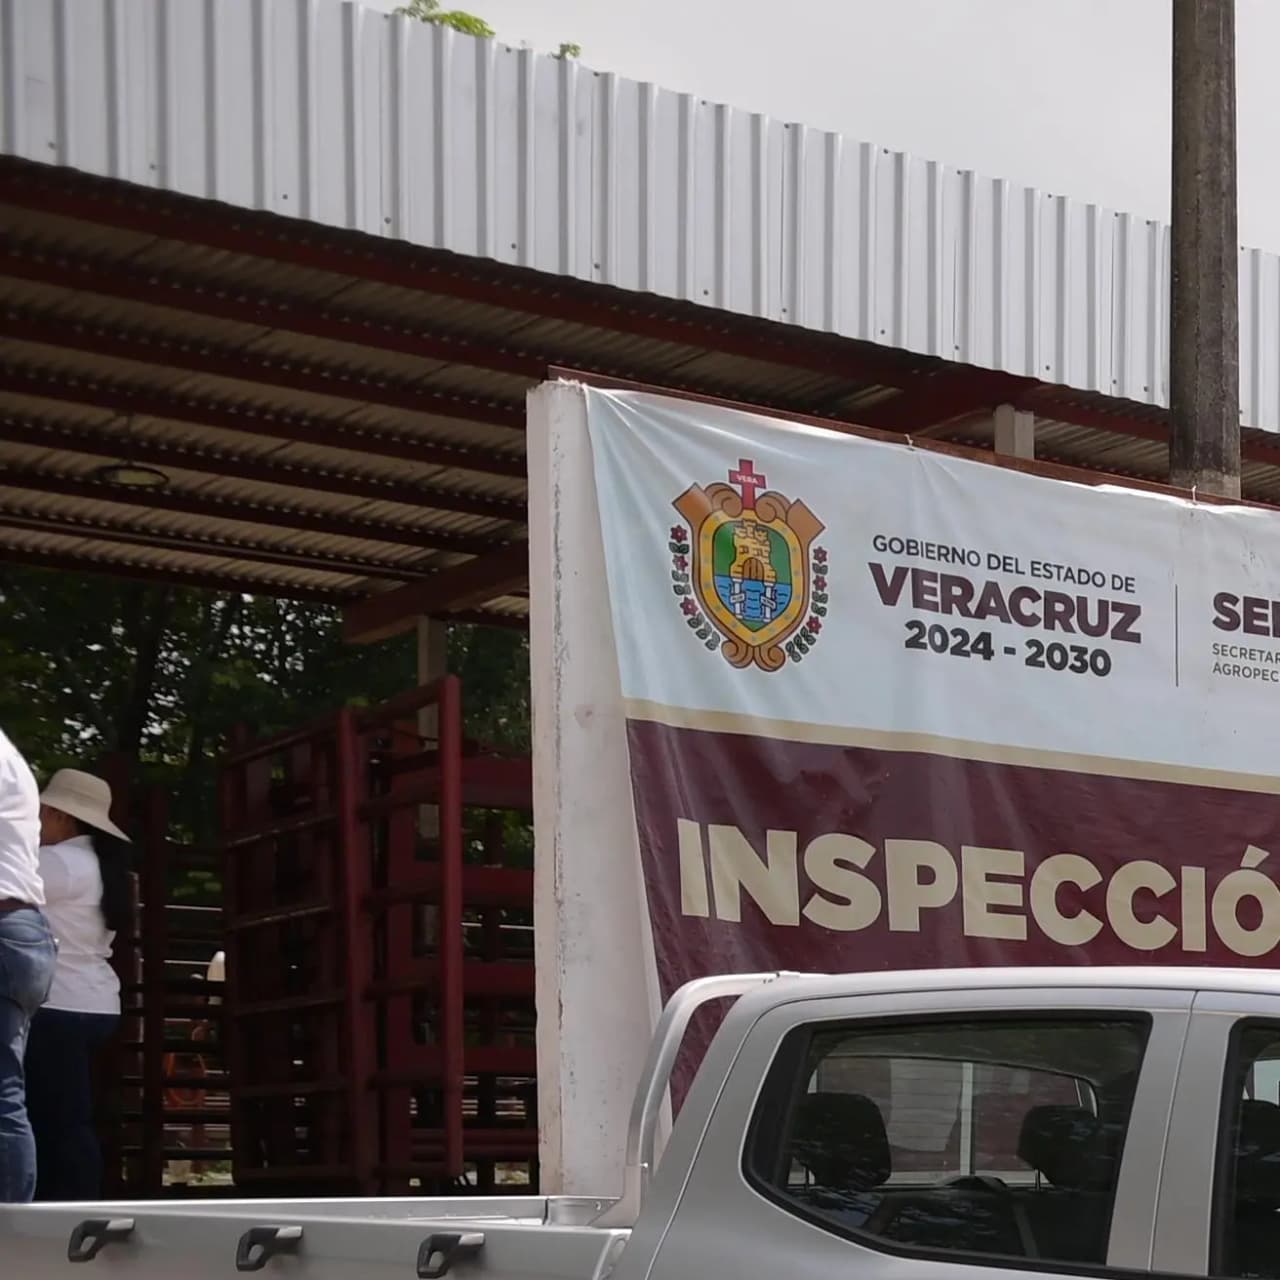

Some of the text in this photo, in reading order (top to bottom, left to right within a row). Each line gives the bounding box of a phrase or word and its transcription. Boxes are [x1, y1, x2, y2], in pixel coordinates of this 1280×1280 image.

[873, 534, 1135, 593] GOBIERNO DEL ESTADO DE
[868, 562, 1141, 643] VERACRUZ
[904, 619, 994, 661] 2024
[1025, 639, 1111, 677] 2030
